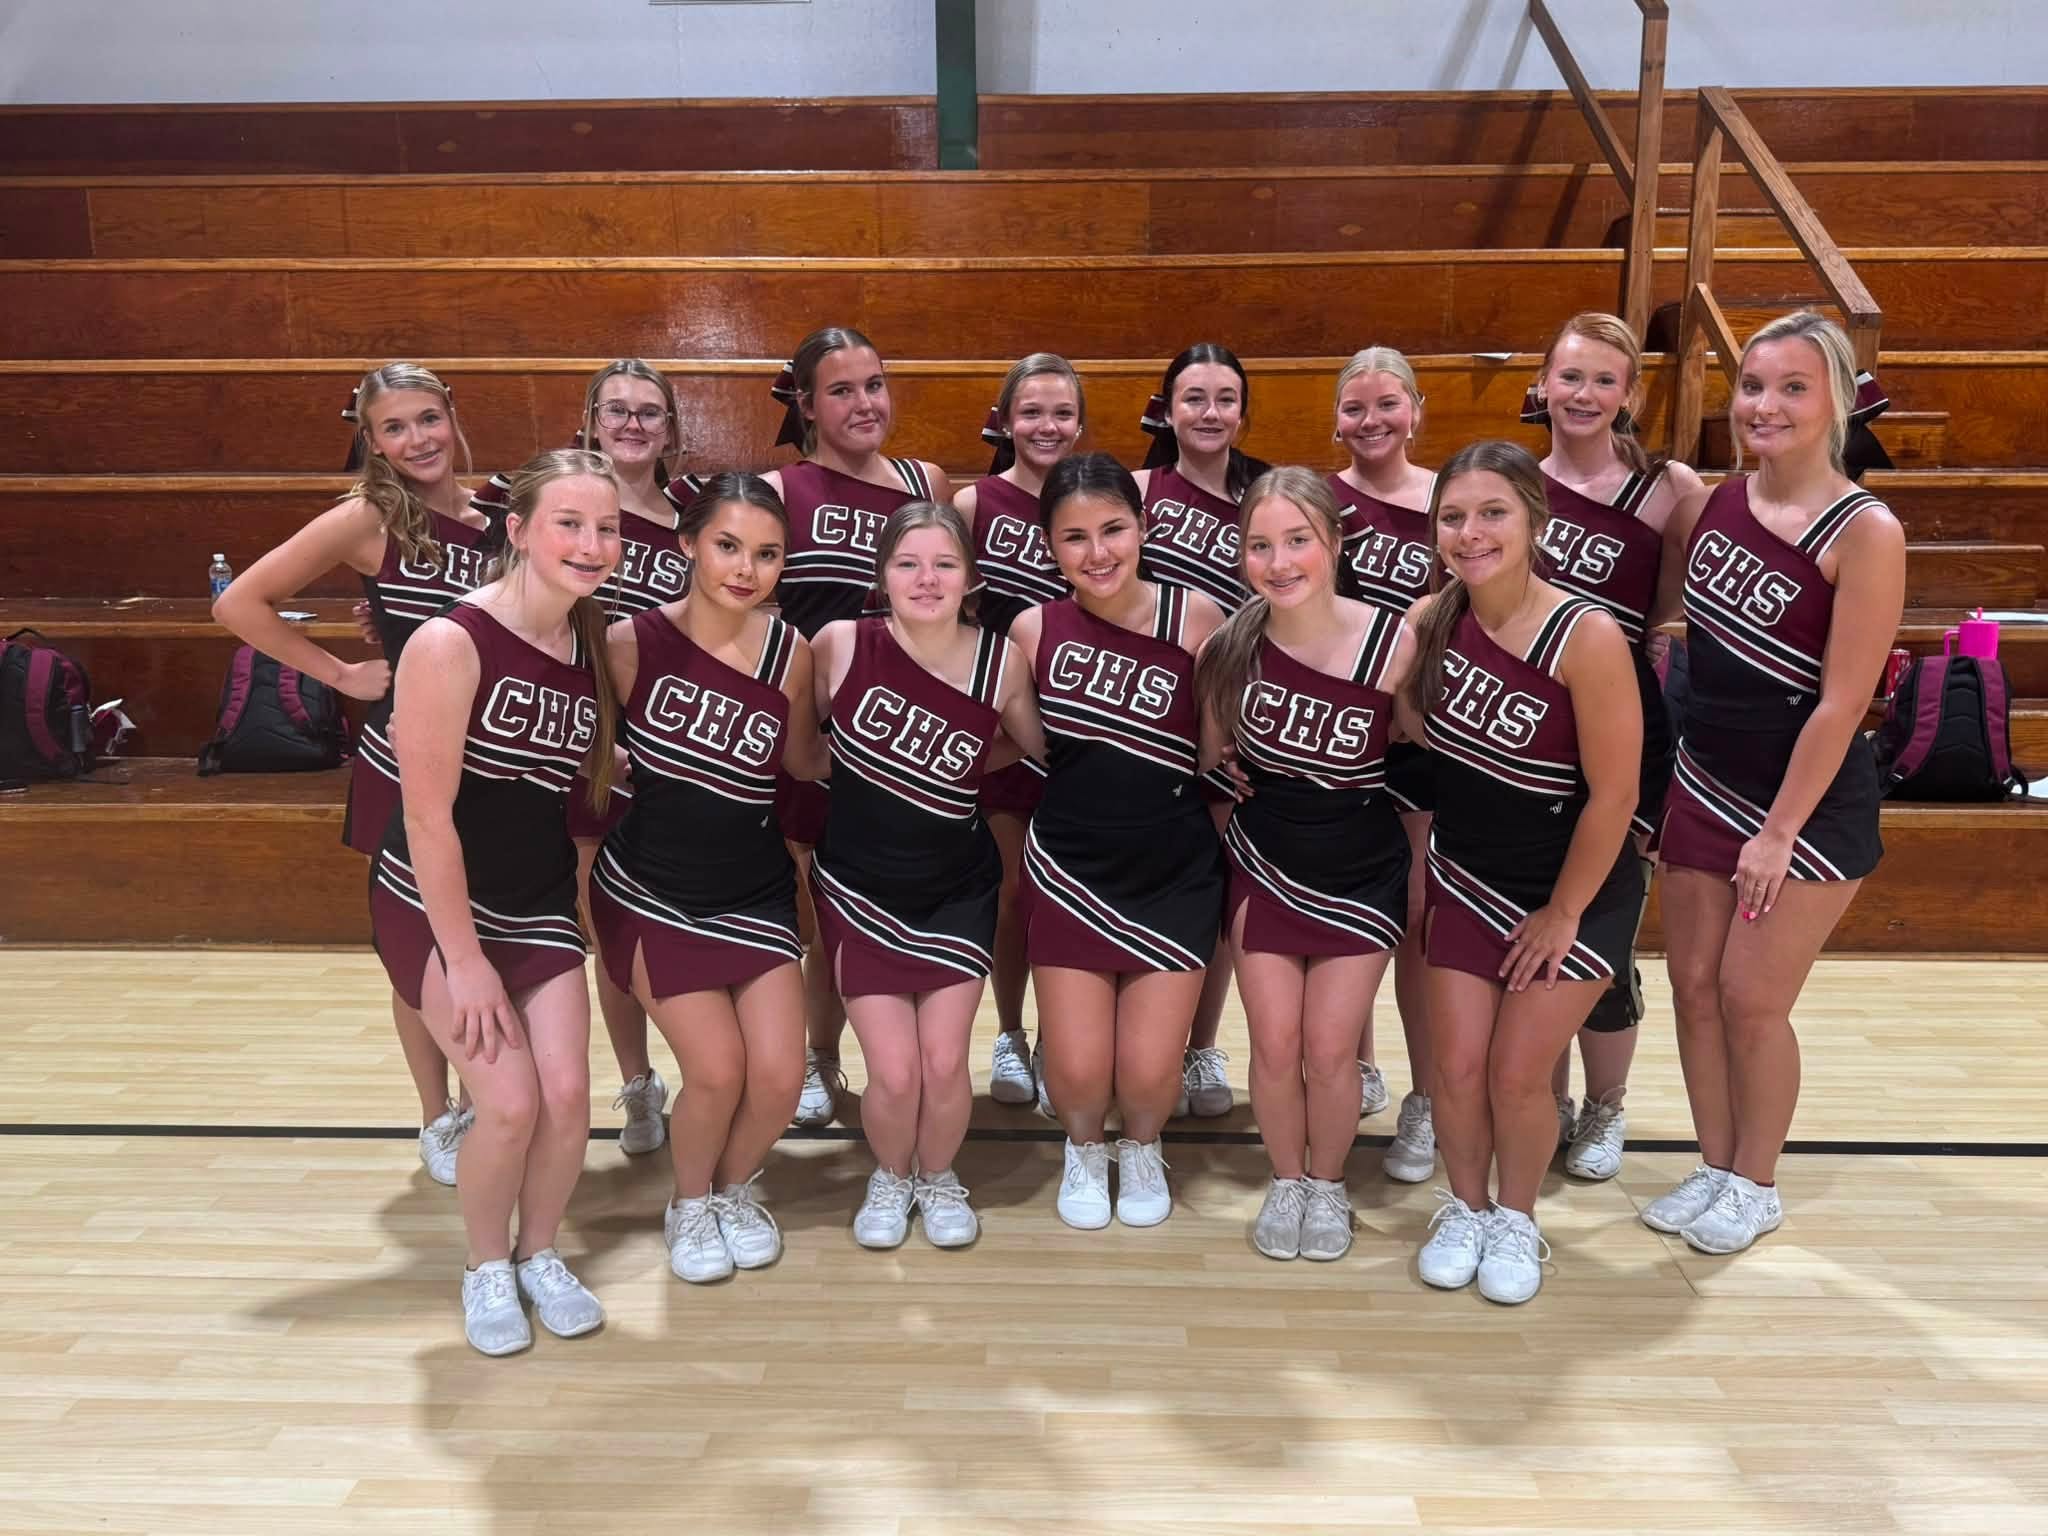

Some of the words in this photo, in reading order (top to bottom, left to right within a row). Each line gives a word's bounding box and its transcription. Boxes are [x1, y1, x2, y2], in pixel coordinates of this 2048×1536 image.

[811, 504, 888, 553] CH
[985, 514, 1046, 570] CH
[1151, 498, 1240, 568] CHS
[1351, 532, 1433, 588] HS
[1542, 518, 1625, 584] HS
[400, 540, 498, 590] CH
[620, 537, 689, 595] HS
[1688, 529, 1802, 627] CHS
[481, 676, 597, 753] CHS
[1049, 640, 1178, 720] CHS
[644, 674, 781, 766] CHS
[852, 686, 983, 781] CHS
[1239, 680, 1375, 759] CHS
